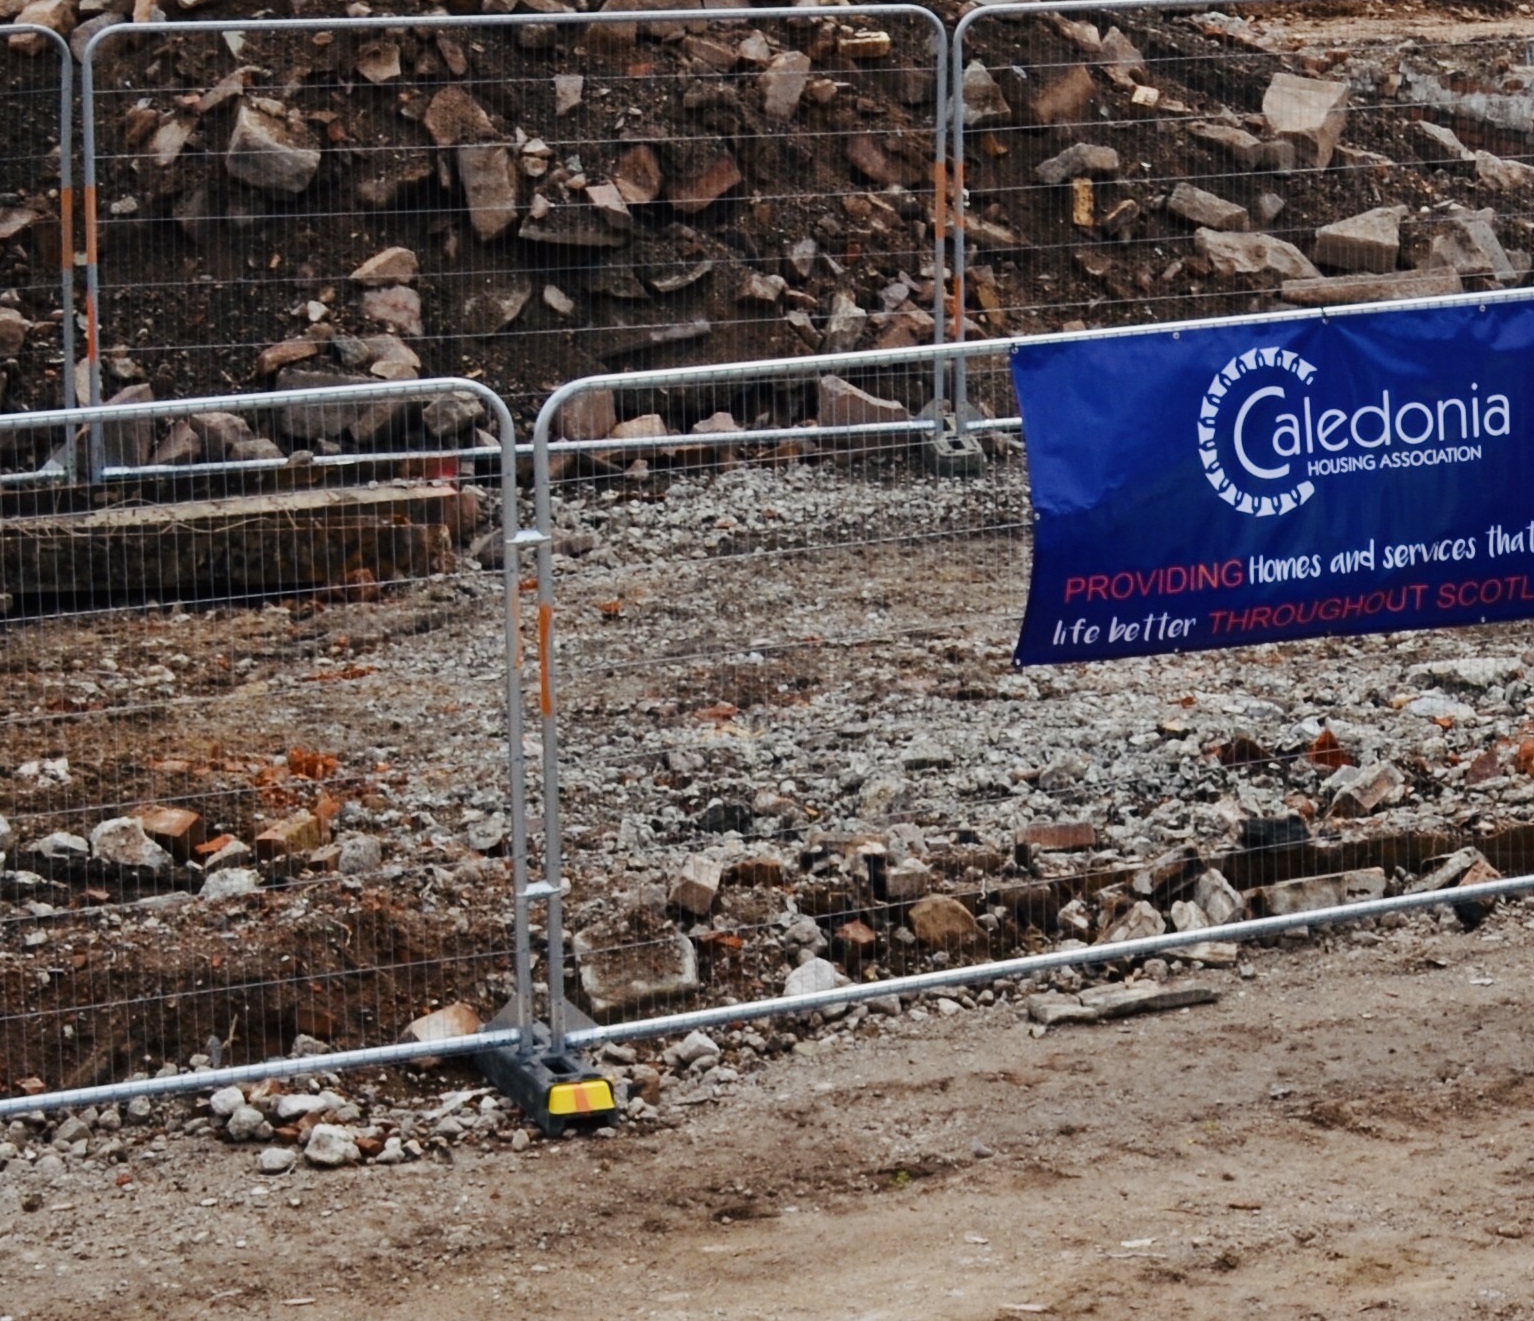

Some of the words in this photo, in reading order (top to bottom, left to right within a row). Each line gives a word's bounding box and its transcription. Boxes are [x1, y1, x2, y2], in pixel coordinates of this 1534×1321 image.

[1233, 382, 1511, 480] Caledonia
[1307, 454, 1376, 477] HOUSING
[1379, 445, 1482, 470] ASSOCIATION
[1063, 559, 1243, 604] PROVIDING
[1249, 554, 1321, 585] Homes
[1330, 538, 1375, 574] and
[1382, 537, 1477, 570] services
[1052, 617, 1101, 645] life
[1107, 611, 1197, 644] better
[1208, 584, 1429, 635] THROUGHOUT
